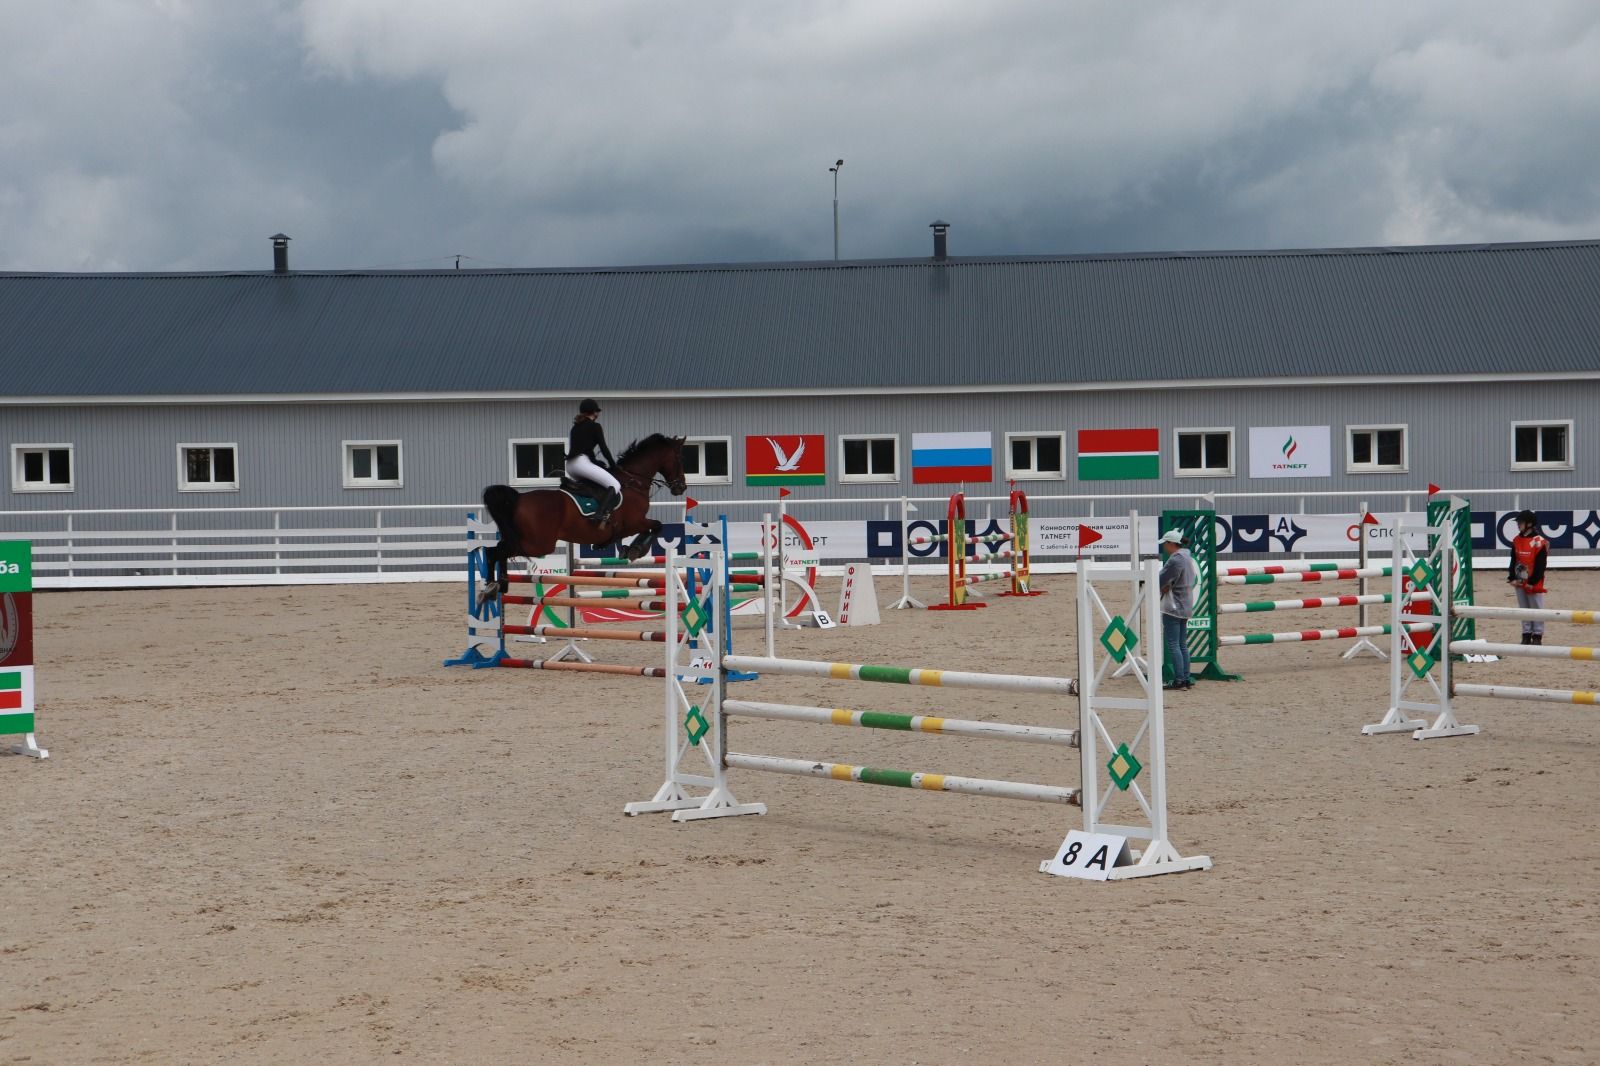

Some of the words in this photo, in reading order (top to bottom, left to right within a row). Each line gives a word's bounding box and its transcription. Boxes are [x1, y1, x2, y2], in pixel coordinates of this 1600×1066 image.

[784, 536, 828, 546] СПРТ
[840, 566, 855, 623] ФИНИШ
[1062, 842, 1083, 866] 8
